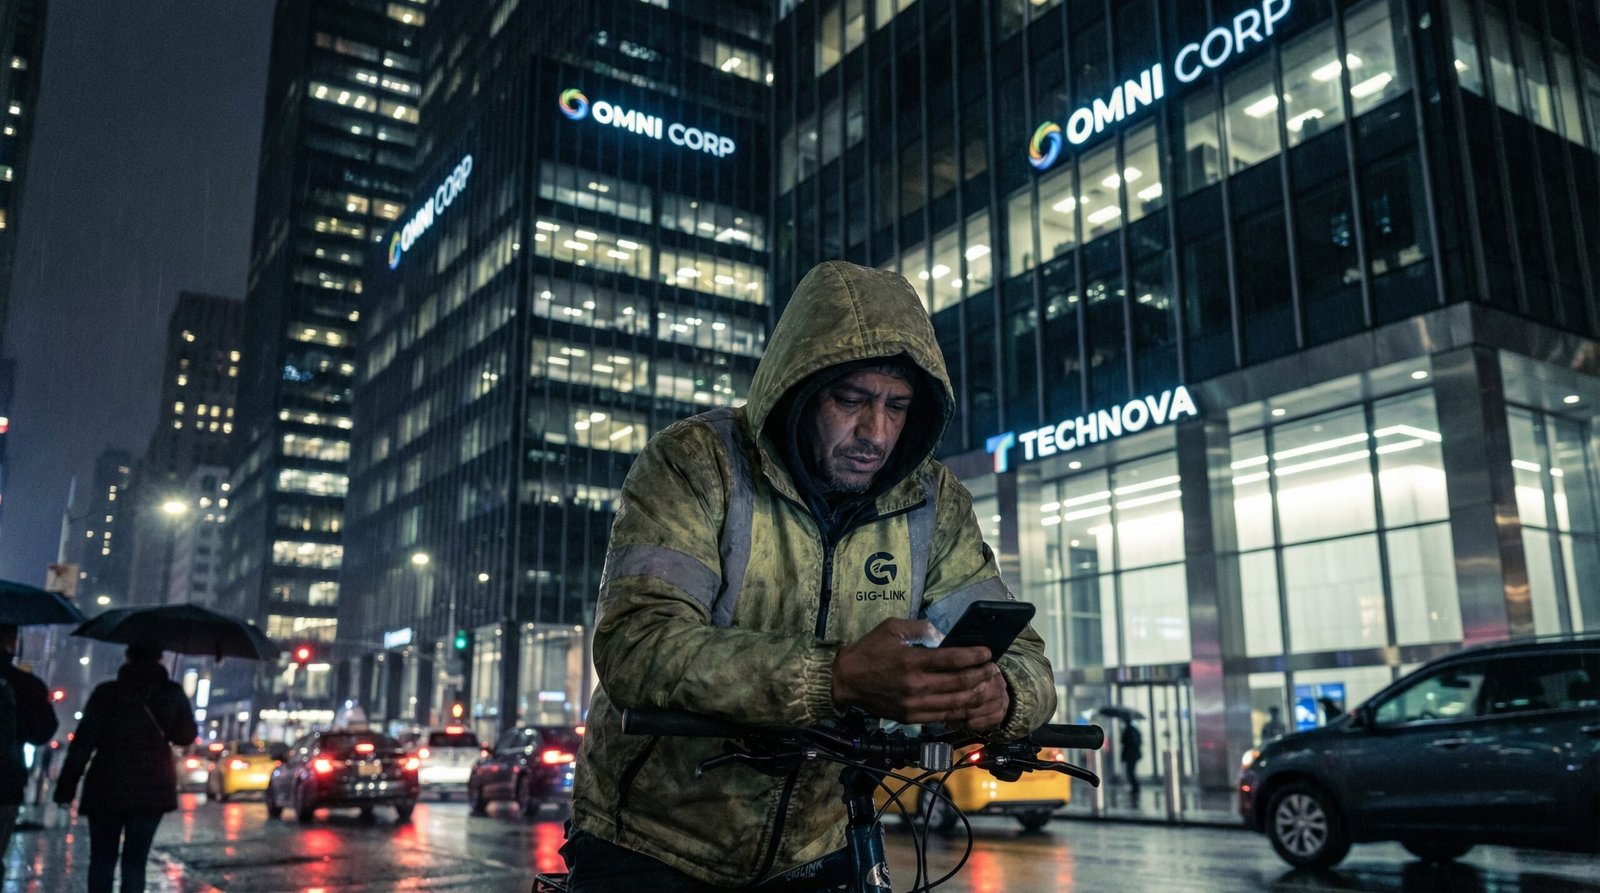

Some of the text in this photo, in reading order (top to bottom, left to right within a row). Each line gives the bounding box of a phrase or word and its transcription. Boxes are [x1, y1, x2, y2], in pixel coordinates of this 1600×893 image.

[1066, 0, 1292, 144] OMNI CORP
[592, 101, 736, 158] OMNI CORP
[401, 154, 473, 252] OMNI CORP
[1018, 386, 1197, 460] TECHNOVA
[855, 590, 906, 601] GIG-LINK
